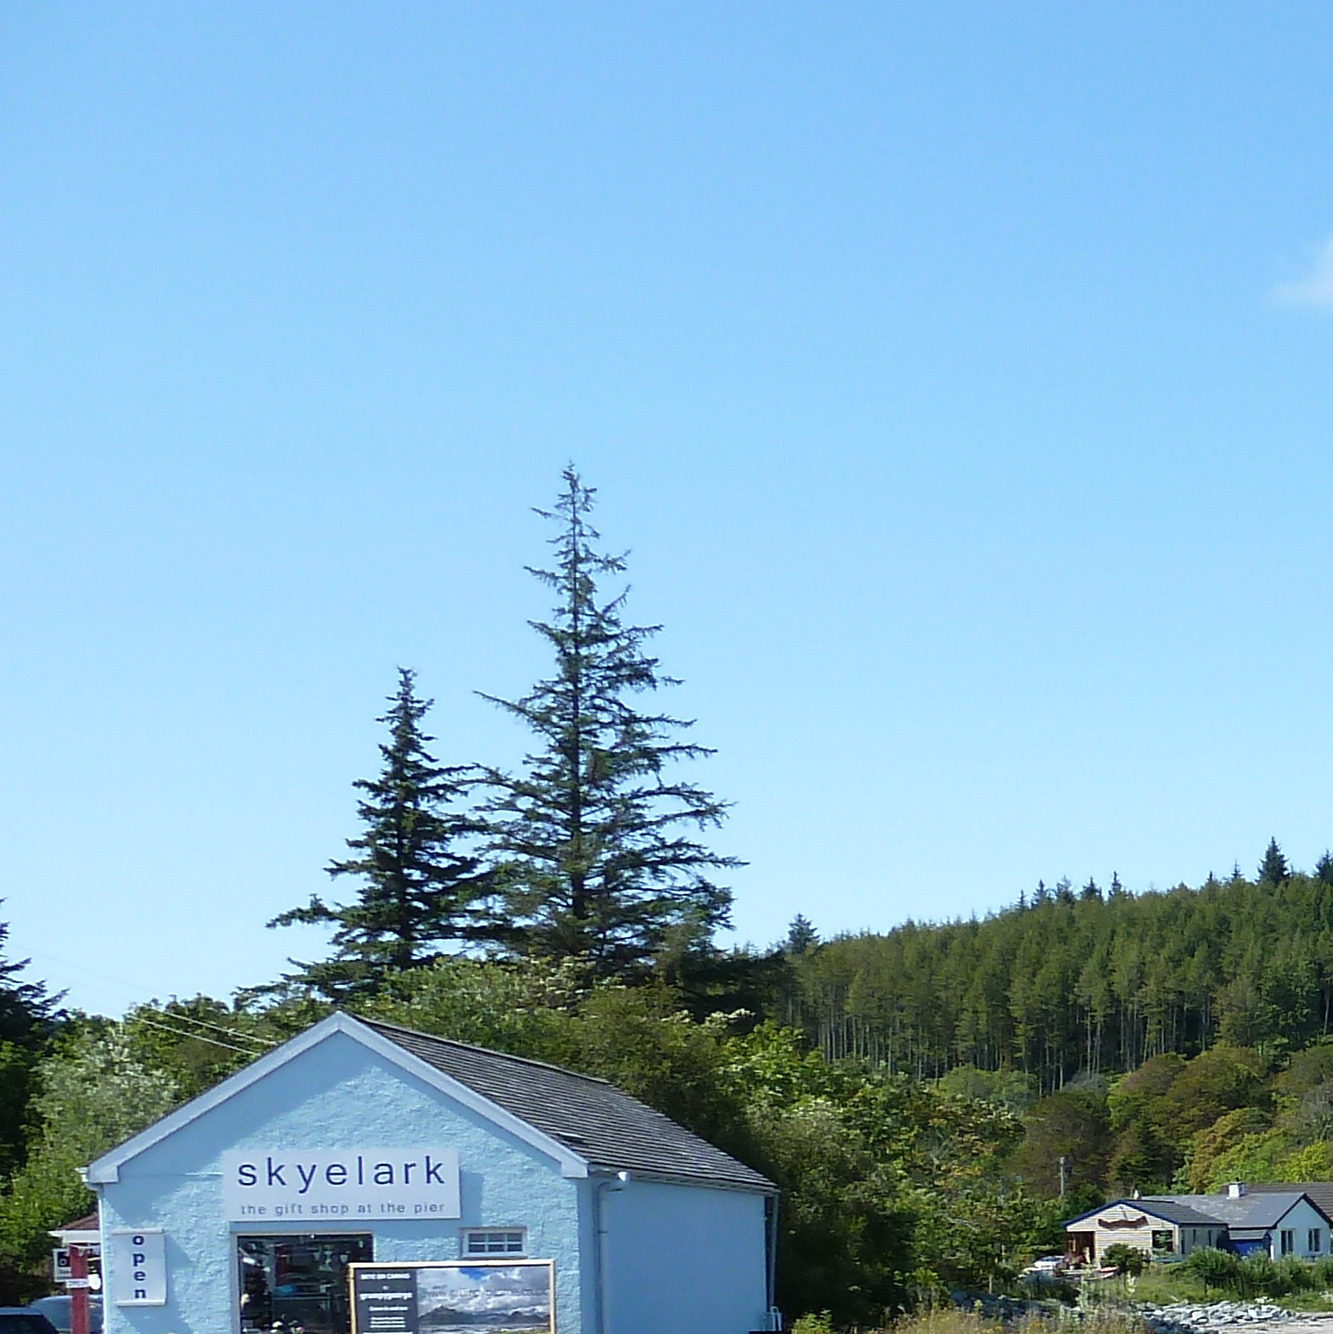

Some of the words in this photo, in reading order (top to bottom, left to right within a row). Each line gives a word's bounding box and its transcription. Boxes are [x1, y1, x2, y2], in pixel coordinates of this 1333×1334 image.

[237, 1156, 446, 1194] skyelark
[241, 1204, 267, 1215] the
[275, 1202, 303, 1217] gift
[311, 1203, 349, 1216] shop
[357, 1203, 372, 1213] at
[380, 1202, 405, 1213] the
[414, 1202, 445, 1215] pier
[131, 1235, 147, 1299] open
